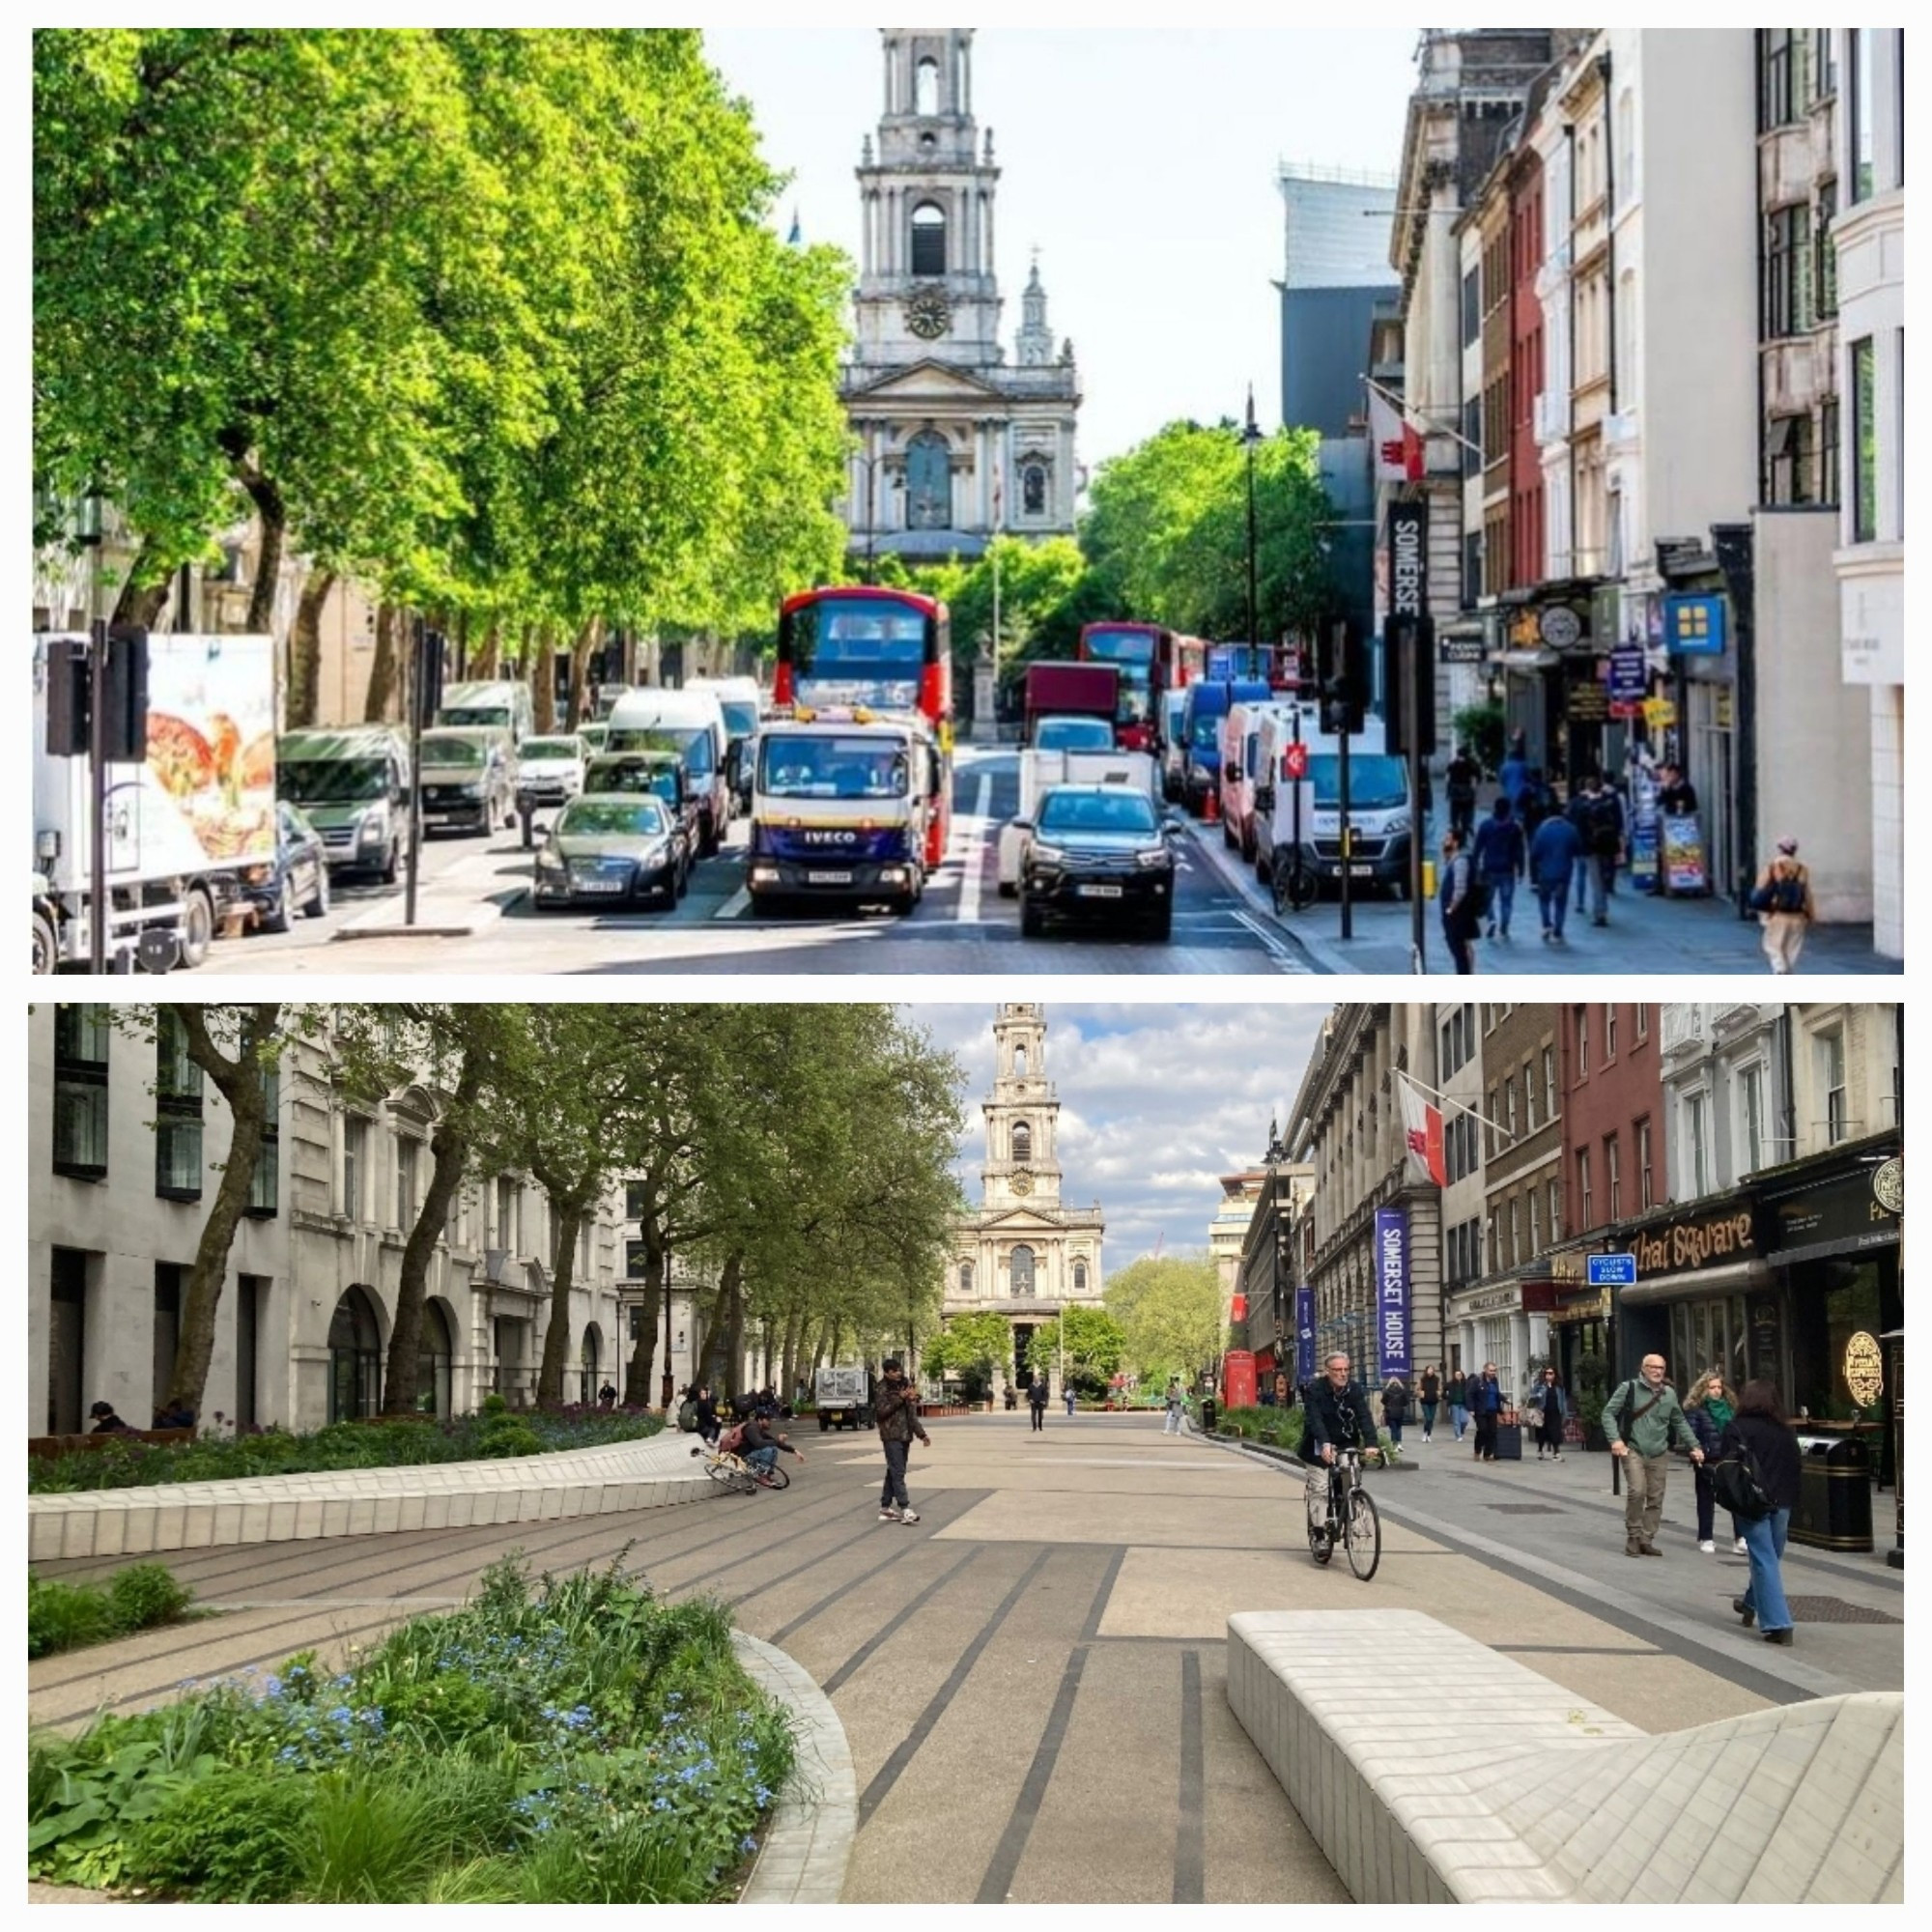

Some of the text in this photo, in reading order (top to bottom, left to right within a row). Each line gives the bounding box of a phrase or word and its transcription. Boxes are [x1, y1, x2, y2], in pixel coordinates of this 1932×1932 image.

[1395, 520, 1419, 617] SOMERSE
[805, 832, 856, 843] IVECO
[1383, 1228, 1403, 1305] SOMERSET
[1629, 1230, 1670, 1271] Thai
[1673, 1213, 1753, 1267] Square
[1384, 1311, 1404, 1358] HOUSE
